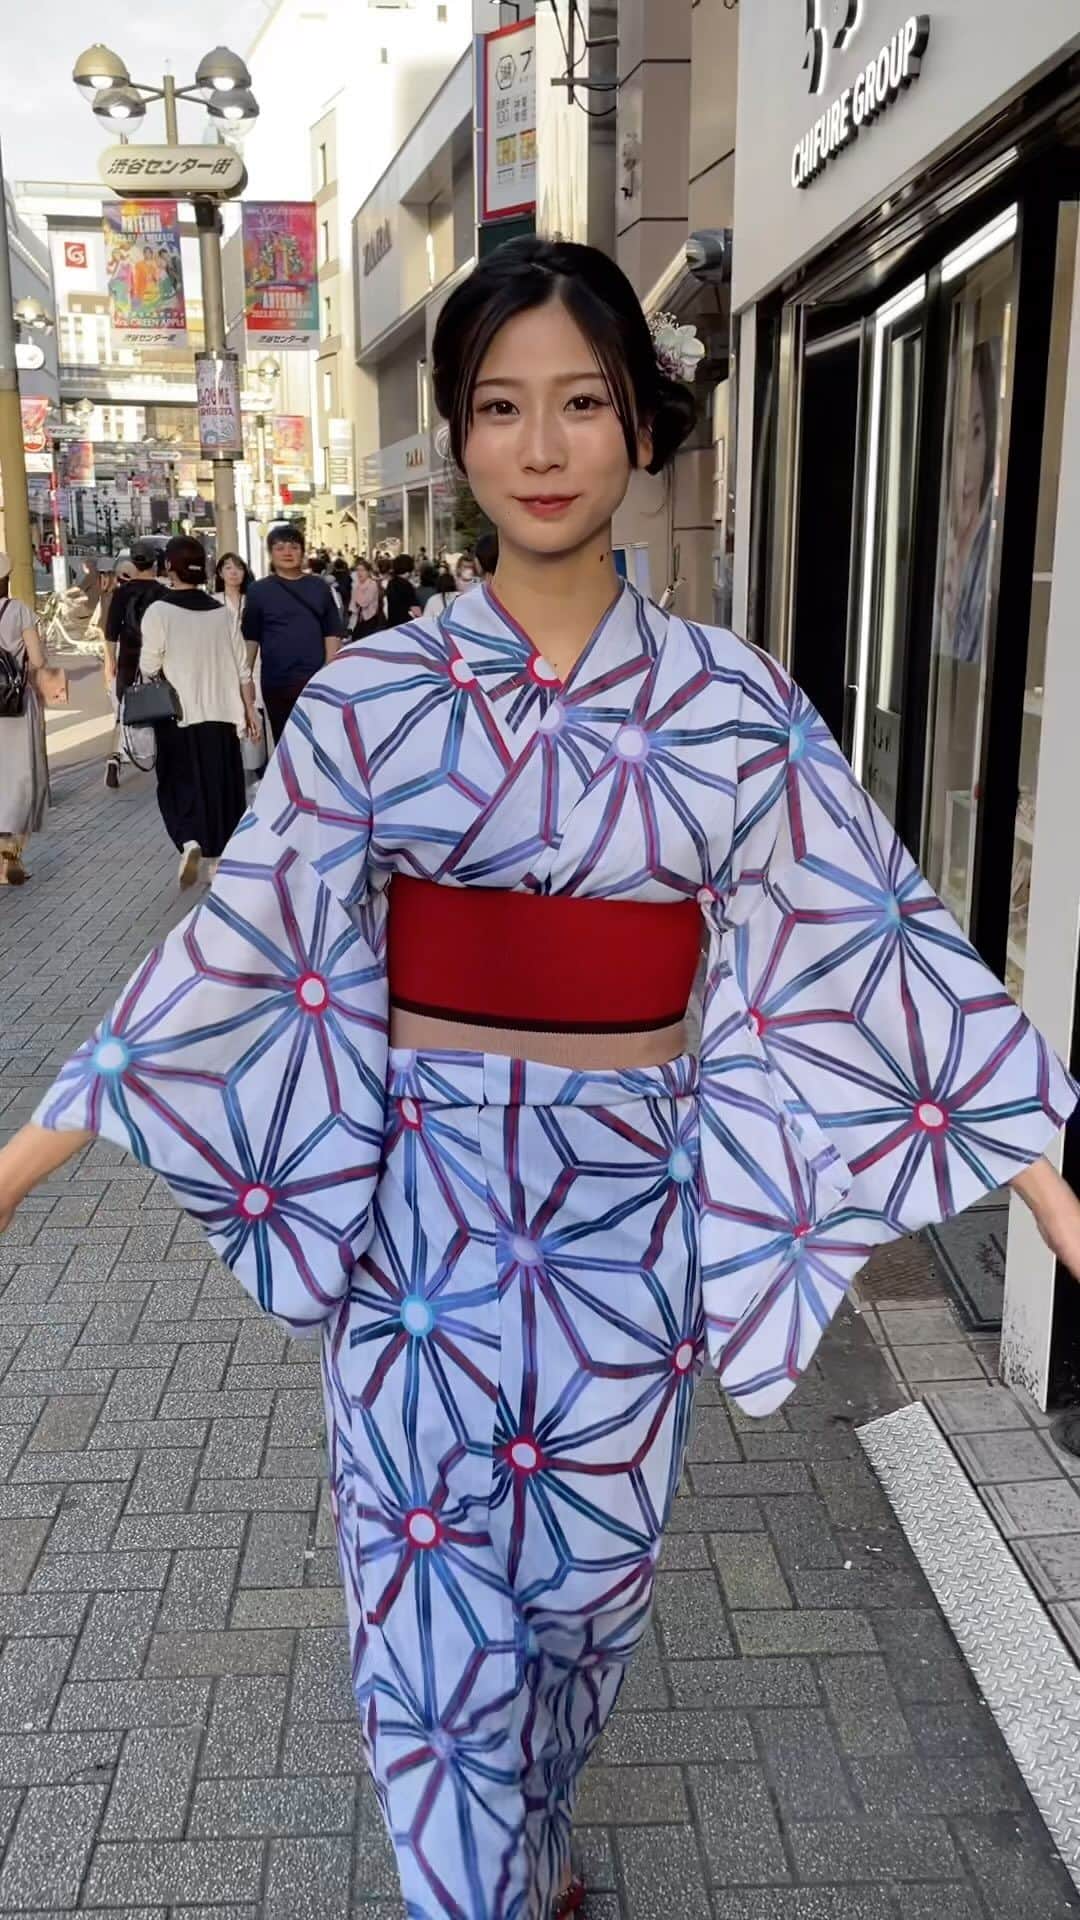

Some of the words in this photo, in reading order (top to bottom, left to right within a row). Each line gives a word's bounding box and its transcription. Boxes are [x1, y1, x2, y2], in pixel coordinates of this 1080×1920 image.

[791, 86, 850, 188] CHIFURE
[853, 15, 920, 126] GROUP
[107, 157, 234, 175] 渋谷センター街
